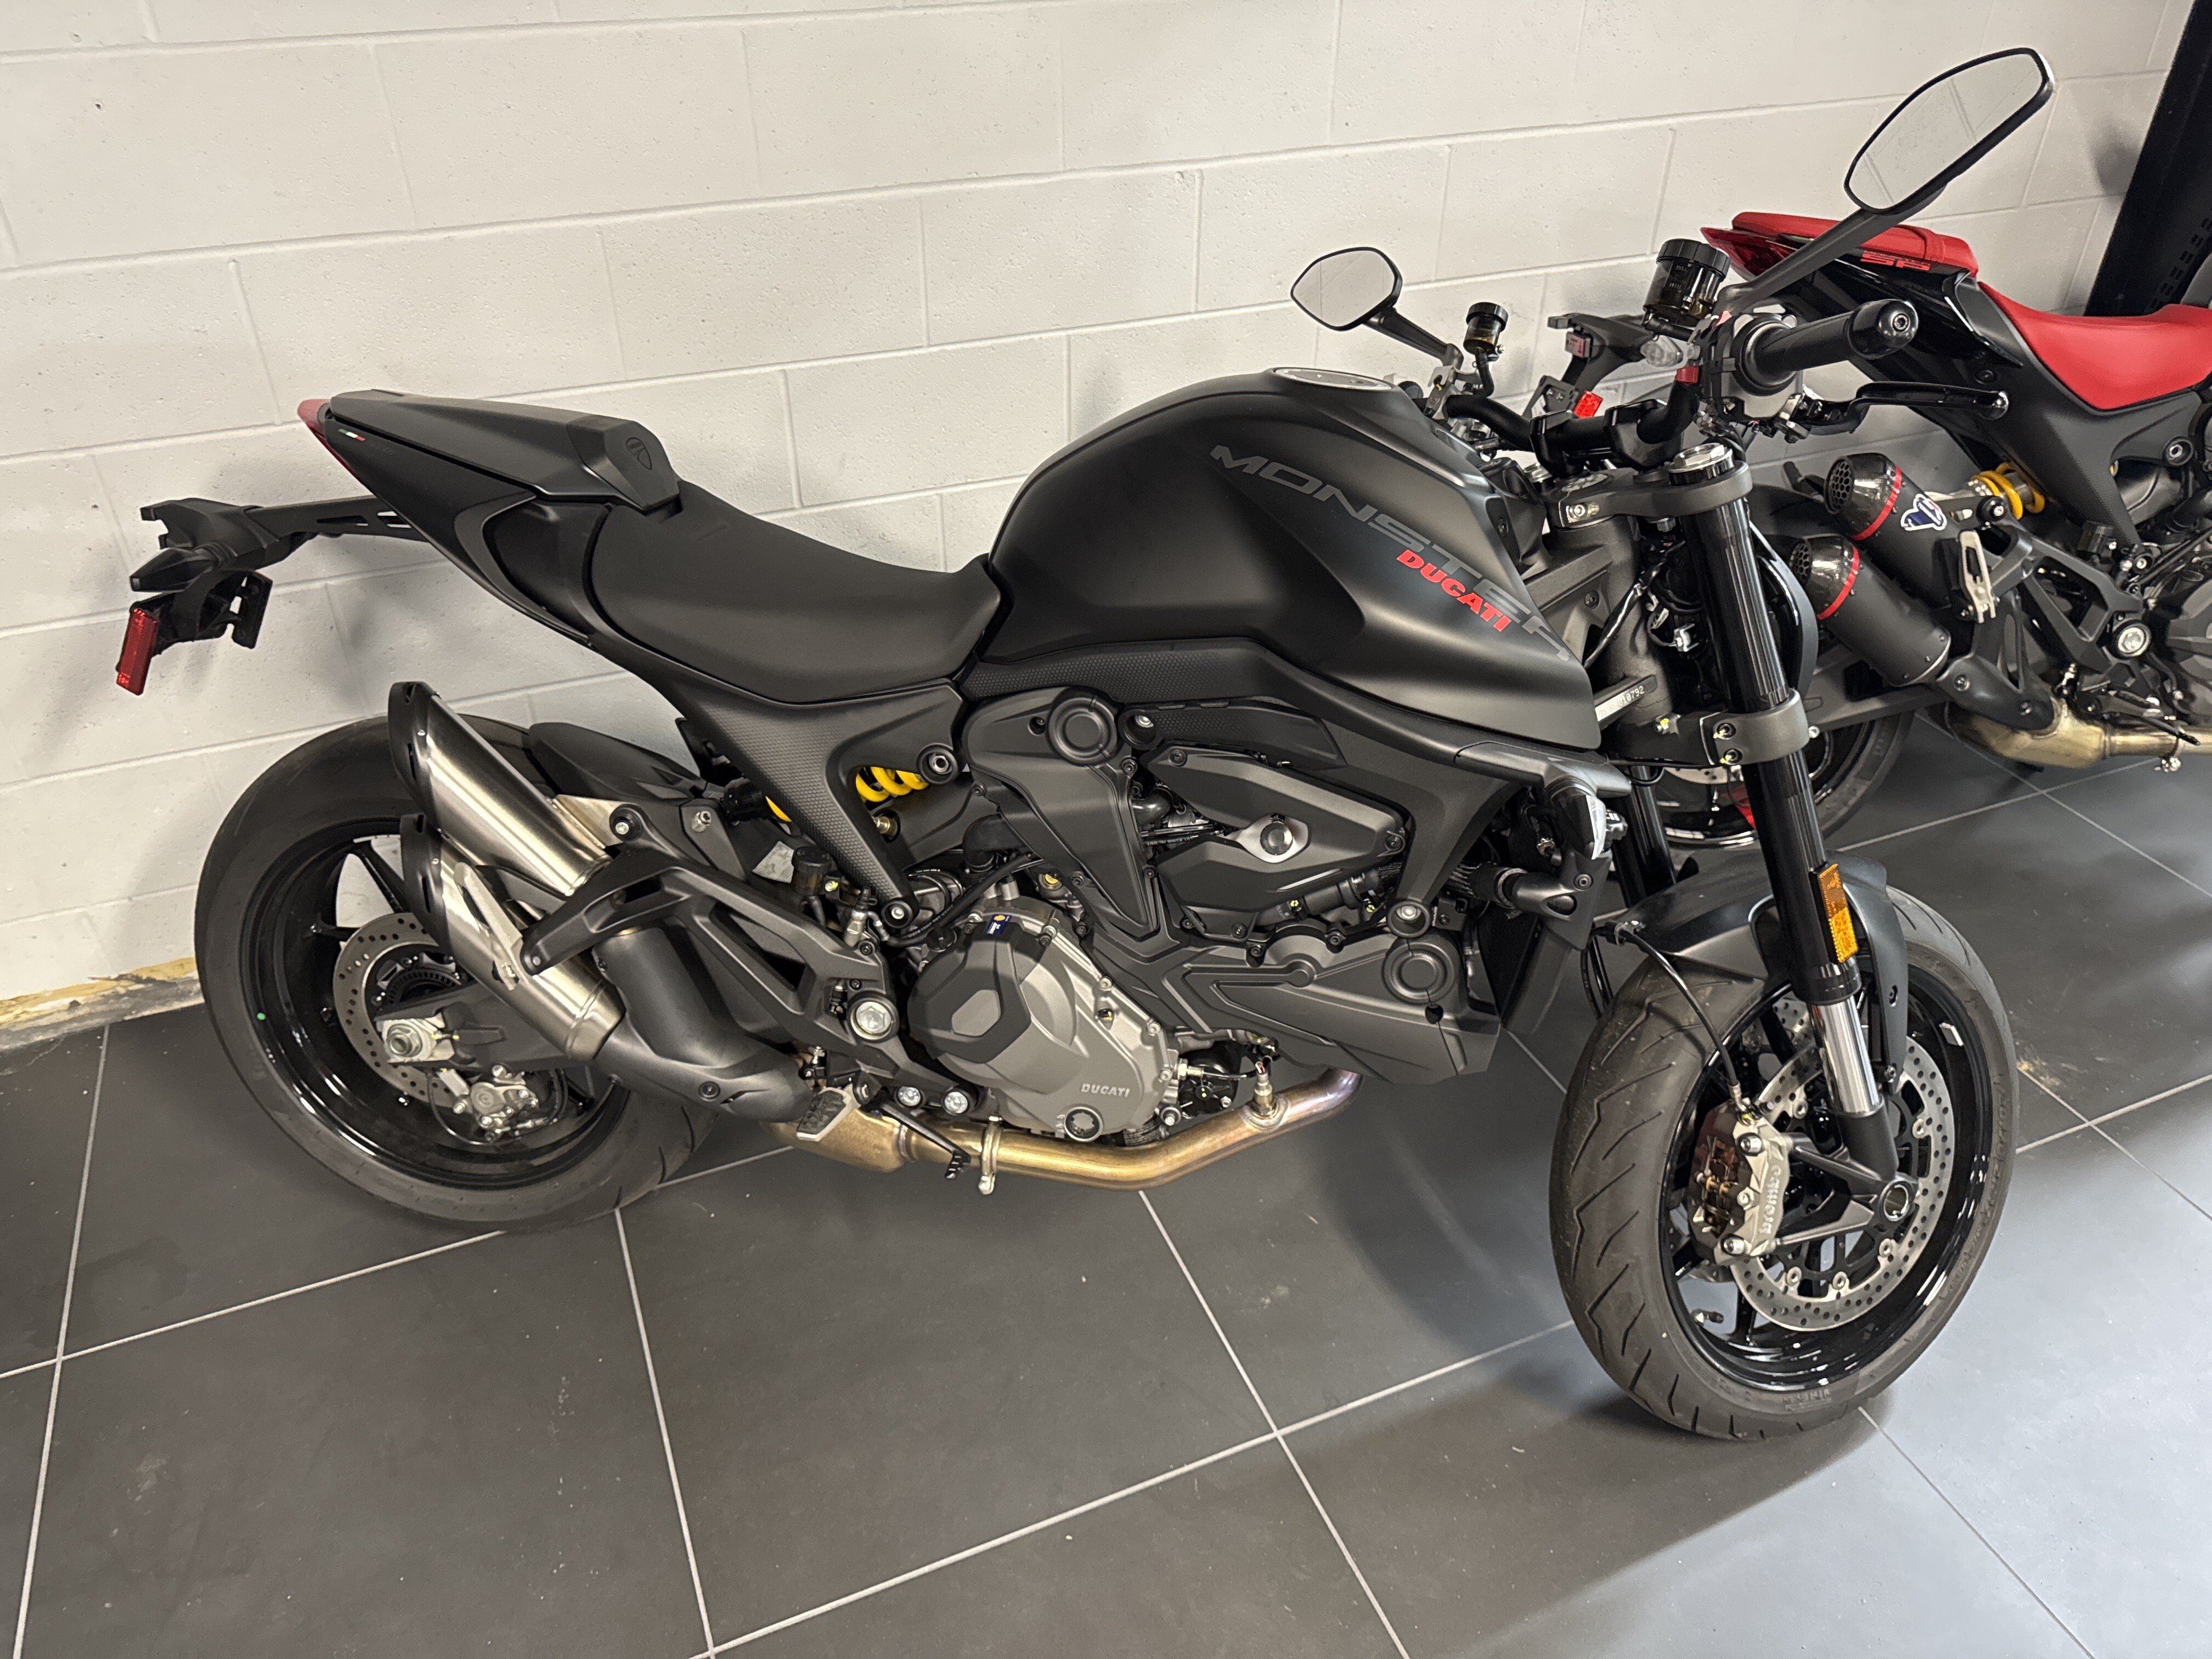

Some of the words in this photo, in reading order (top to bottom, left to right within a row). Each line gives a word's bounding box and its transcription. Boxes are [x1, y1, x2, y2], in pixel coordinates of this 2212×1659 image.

[1396, 549, 1512, 632] DUCATI
[1080, 1083, 1131, 1097] DUCATI
[1758, 1165, 1781, 1234] brembo
